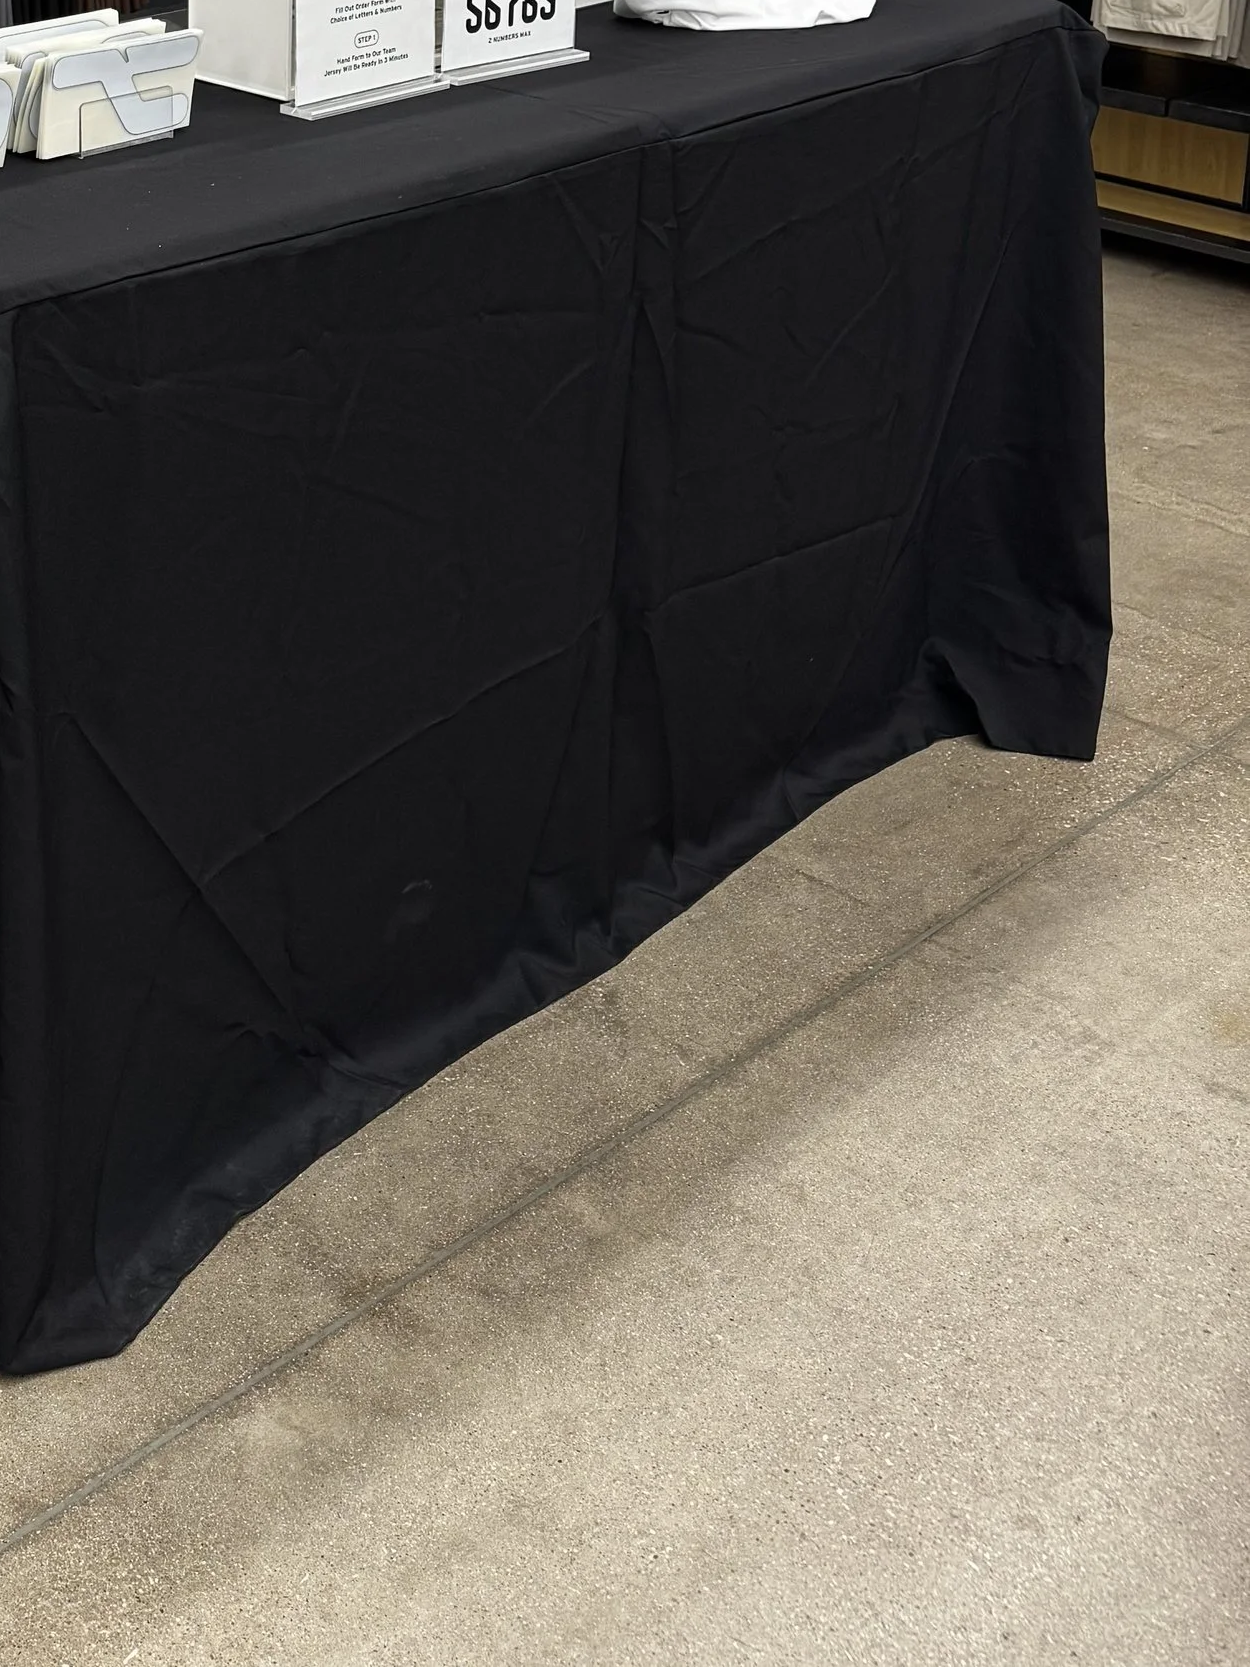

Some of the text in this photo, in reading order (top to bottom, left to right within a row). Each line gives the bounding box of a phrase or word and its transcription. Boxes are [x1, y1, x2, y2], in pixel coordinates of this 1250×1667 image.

[330, 15, 348, 24] Choice
[355, 10, 374, 19] Letters
[380, 5, 402, 14] Numbers
[335, 6, 344, 14] Fill
[344, 5, 354, 13] Out
[355, 2, 370, 10] Order
[371, 0, 384, 7] Form
[358, 35, 372, 44] STEP
[493, 33, 519, 43] NUMBERS
[337, 56, 350, 65] Hand
[352, 54, 365, 62] Form
[383, 47, 396, 55] Team
[324, 68, 341, 77] Jersey
[343, 65, 352, 73] Will
[353, 63, 360, 71] Be
[361, 60, 377, 69] Ready
[389, 53, 408, 62] Minutes
